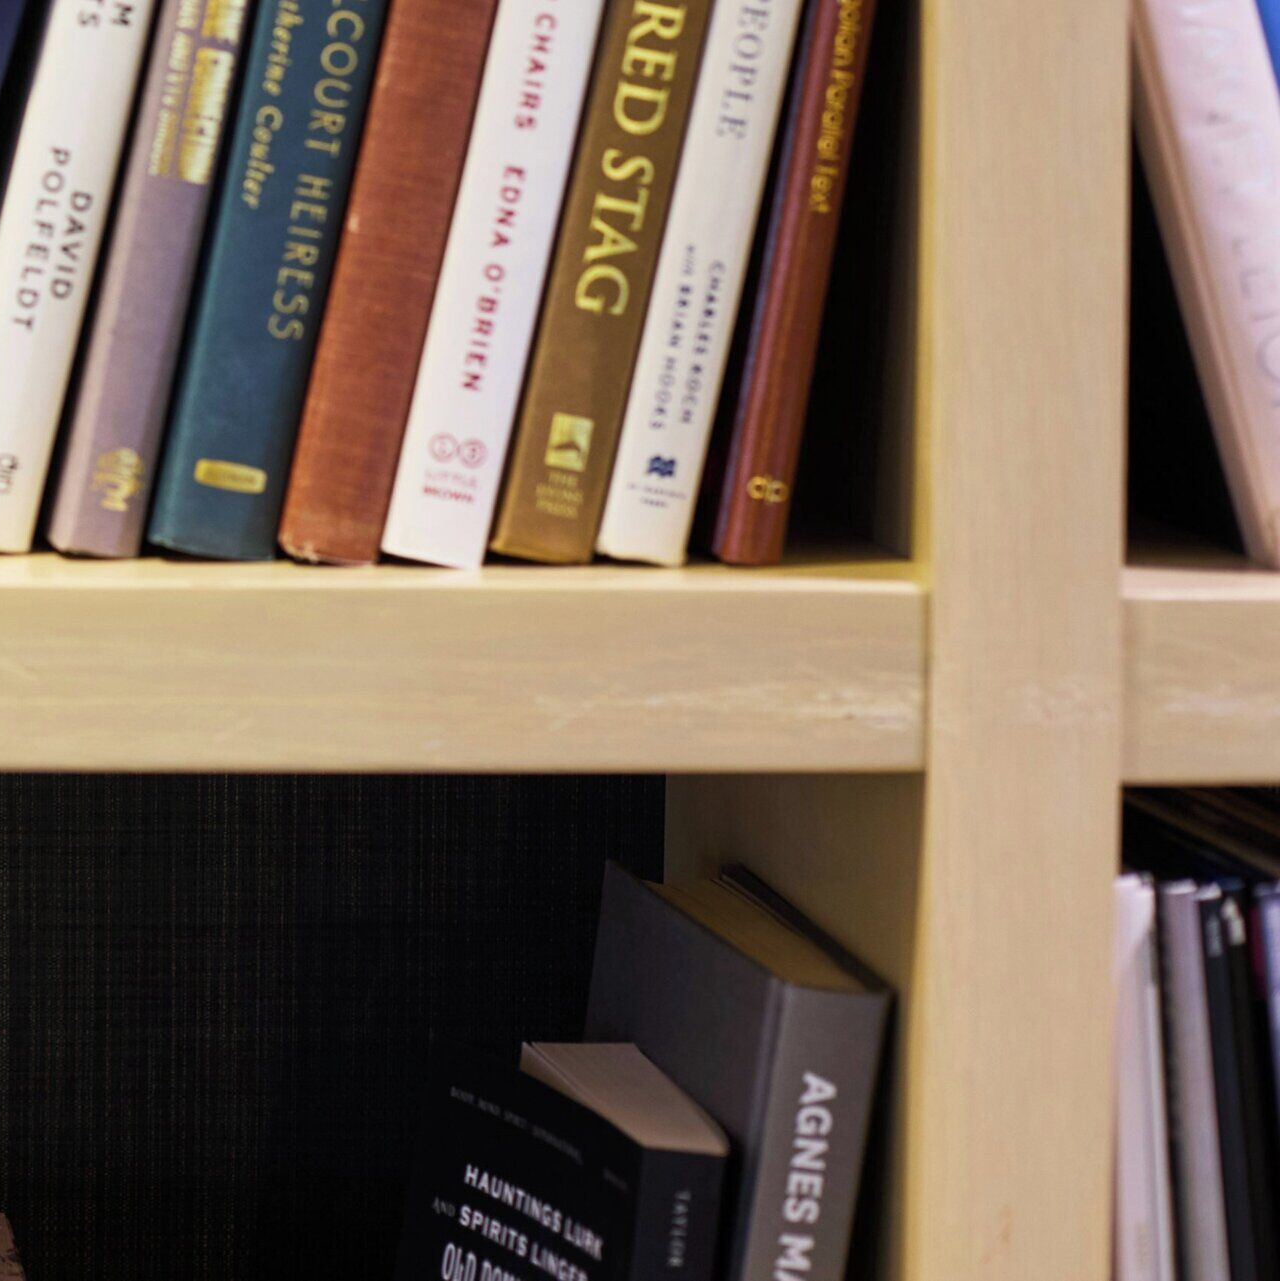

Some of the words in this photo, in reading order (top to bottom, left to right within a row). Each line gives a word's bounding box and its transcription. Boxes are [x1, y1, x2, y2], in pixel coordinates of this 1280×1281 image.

[511, 10, 559, 133] CHAIRS
[816, 67, 854, 162] Parallel
[236, 102, 286, 212] Coulter
[805, 162, 838, 215] Text
[9, 145, 72, 332] POLFELDT
[47, 189, 94, 303] DAVID
[265, 172, 334, 344] HEIRESS
[487, 163, 527, 253] EDNA
[572, 145, 659, 321] STAG
[457, 261, 507, 395] O'BRIEN
[665, 281, 693, 349] BRIAN
[691, 258, 726, 358] CHARLES
[648, 353, 679, 432] HOOKS
[678, 361, 706, 426] KOCH
[782, 1071, 838, 1224] AGNES
[432, 1196, 457, 1219] AND
[458, 1204, 529, 1258] SPIRITS
[463, 1163, 563, 1234] HAUNTINGS
[562, 1215, 605, 1262] LURK
